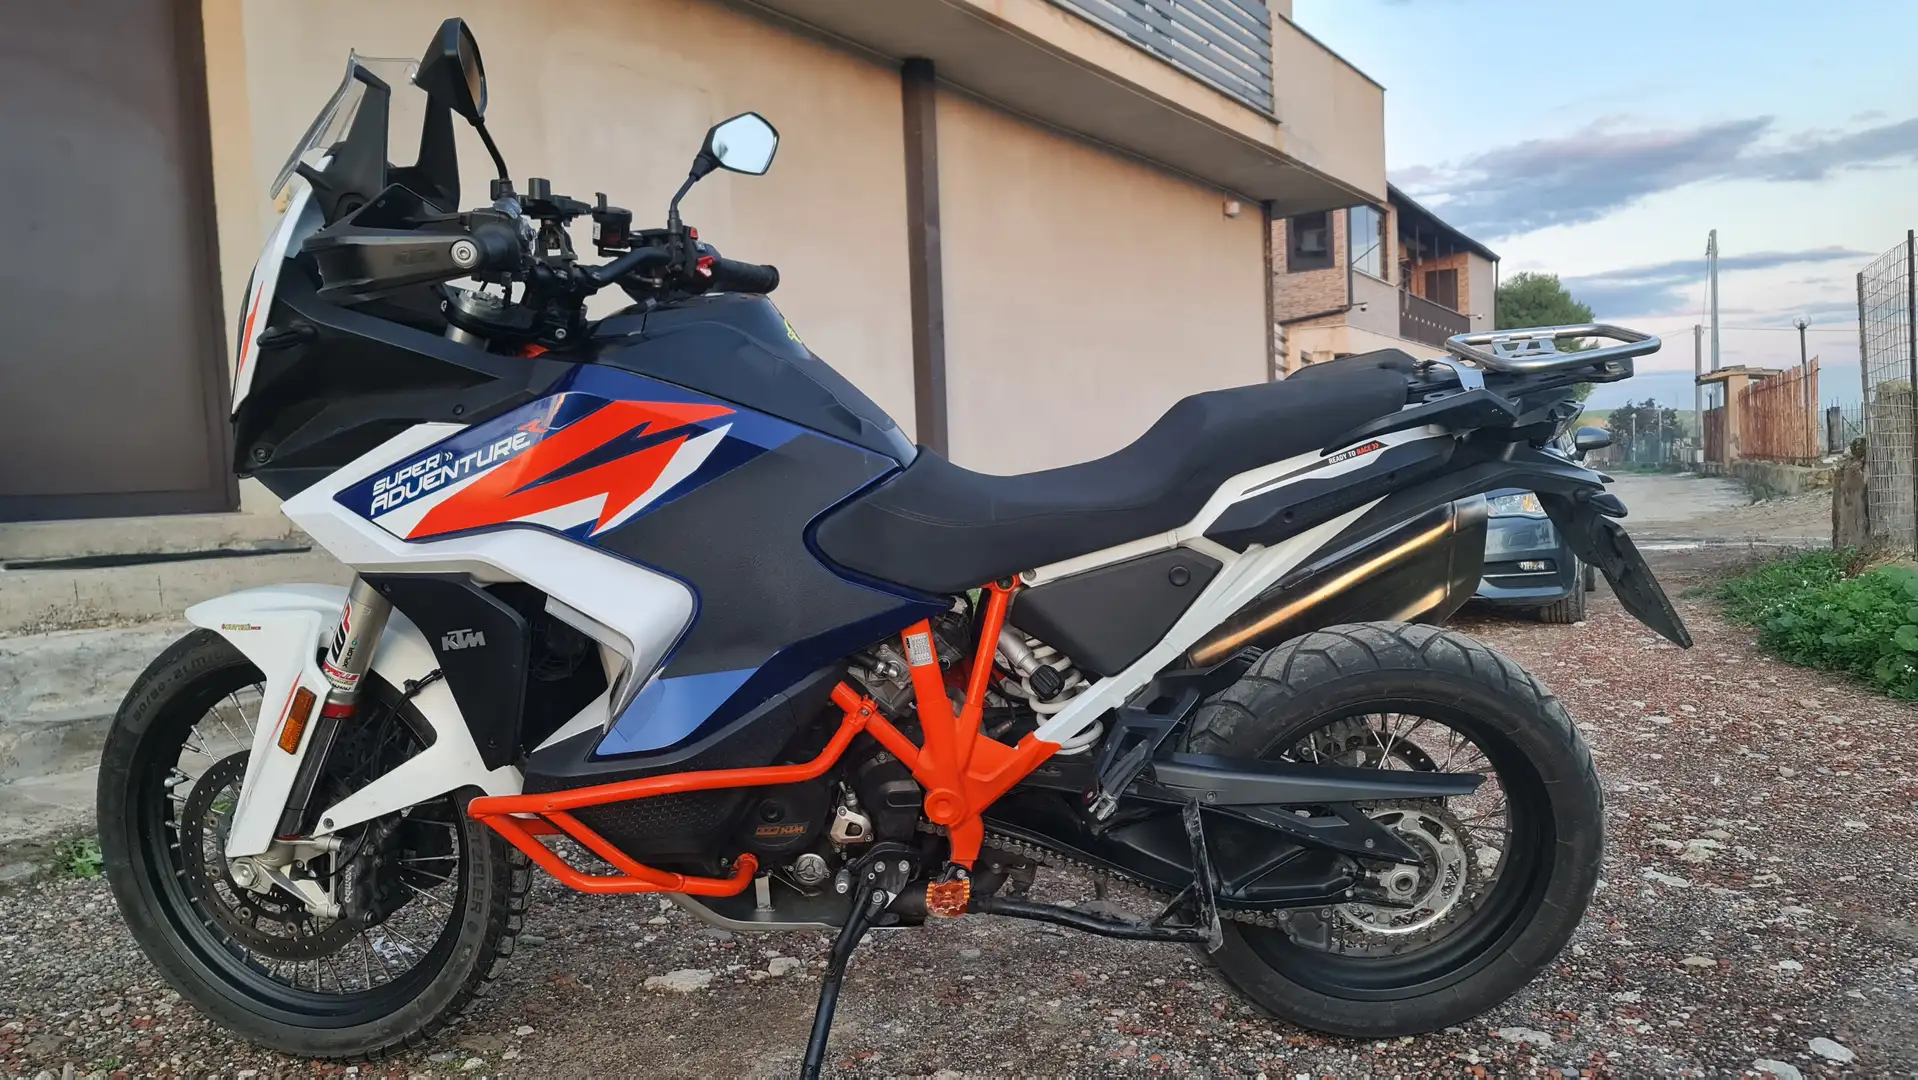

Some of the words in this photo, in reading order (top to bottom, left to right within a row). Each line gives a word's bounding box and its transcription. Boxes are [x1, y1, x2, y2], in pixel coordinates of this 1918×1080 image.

[370, 431, 531, 516] ADVENTURE
[373, 452, 441, 497] SUPER
[1328, 453, 1347, 465] READY
[1348, 450, 1357, 458] TO
[1356, 445, 1372, 456] RACE
[441, 628, 486, 651] KTM
[467, 819, 486, 915] ETZELER
